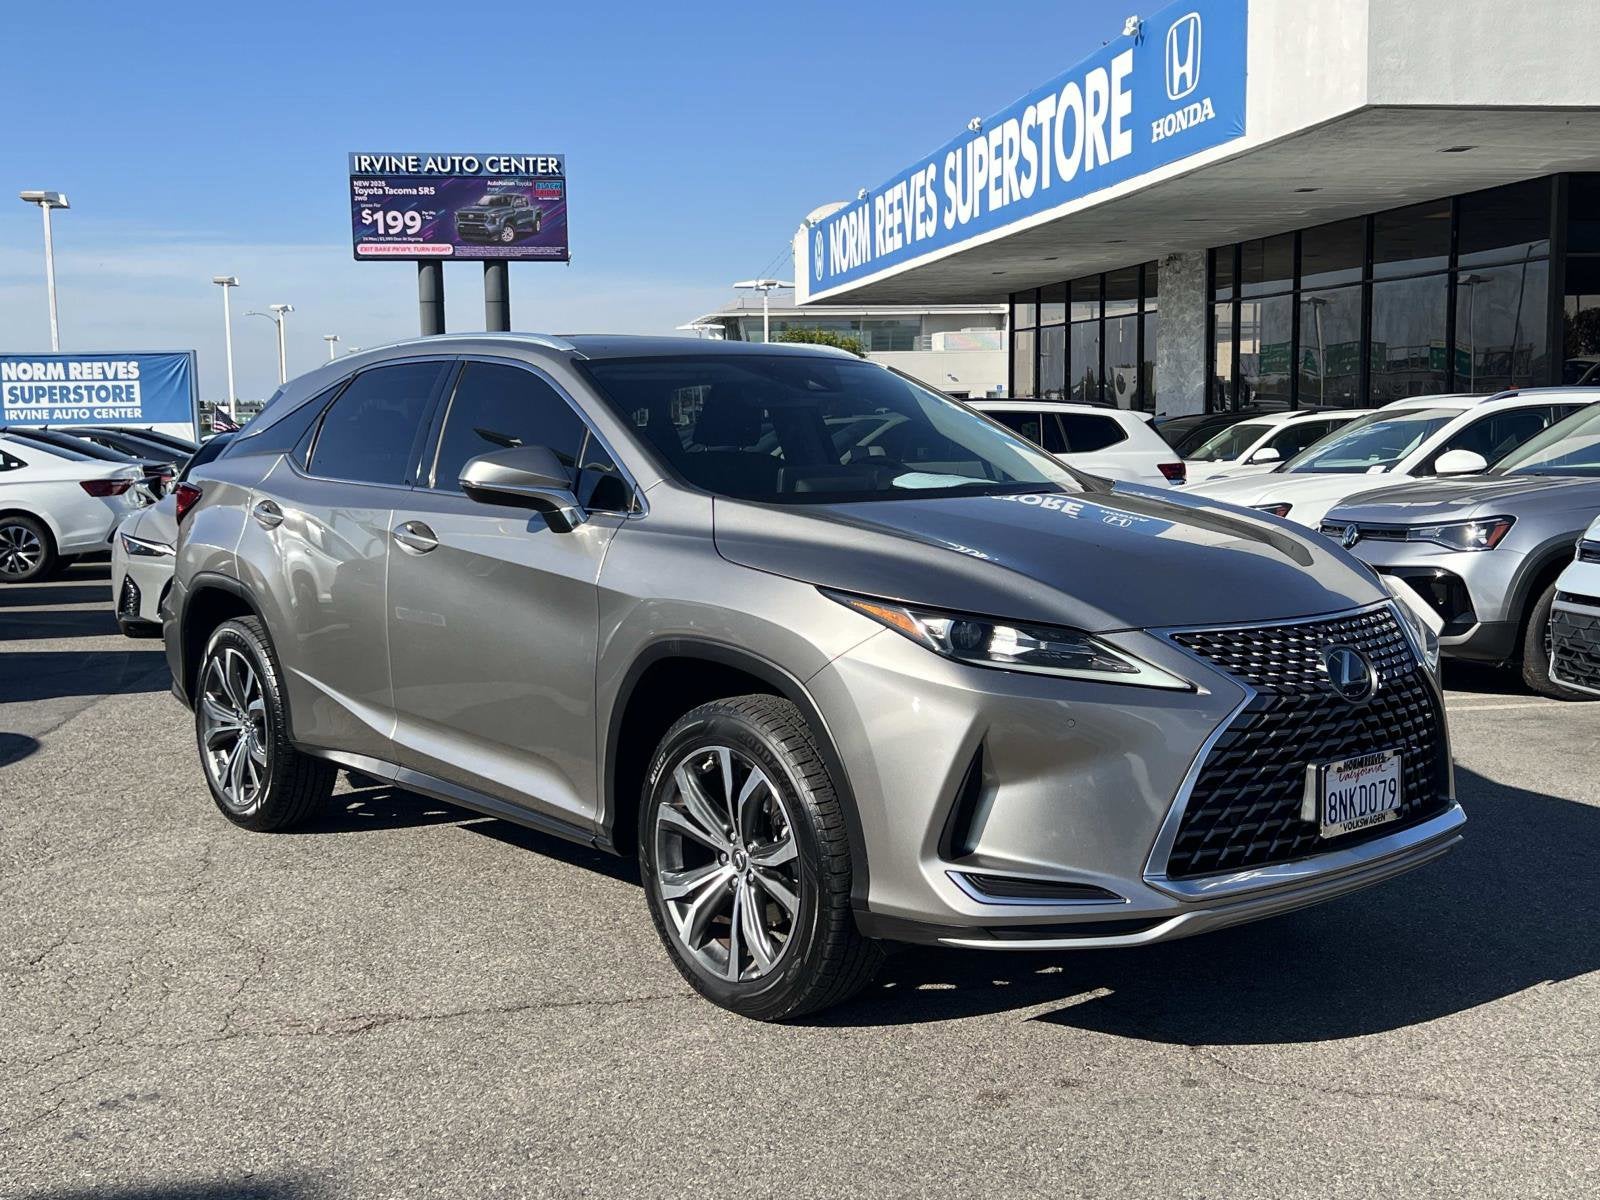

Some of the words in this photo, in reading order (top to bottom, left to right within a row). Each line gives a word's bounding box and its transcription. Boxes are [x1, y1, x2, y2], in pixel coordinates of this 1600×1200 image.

[1151, 97, 1215, 144] HONDA
[354, 155, 417, 173] IRVINE
[424, 156, 479, 173] AUTO
[485, 155, 560, 173] CENTER
[829, 202, 871, 276] NORM
[875, 163, 938, 258] REEVES
[944, 49, 1133, 230] SUPERSTORE
[354, 187, 384, 196] Toyota
[384, 187, 418, 195] Tacoma
[418, 187, 436, 195] SR5
[361, 208, 422, 235] $199
[1, 362, 65, 380] NORM
[68, 361, 140, 380] REEVES
[8, 384, 136, 404] SUPERSTORE
[5, 409, 49, 420] IRVINE
[53, 409, 90, 420] AUTO
[93, 408, 142, 419] CENTER
[1328, 778, 1397, 824] 8NKD079
